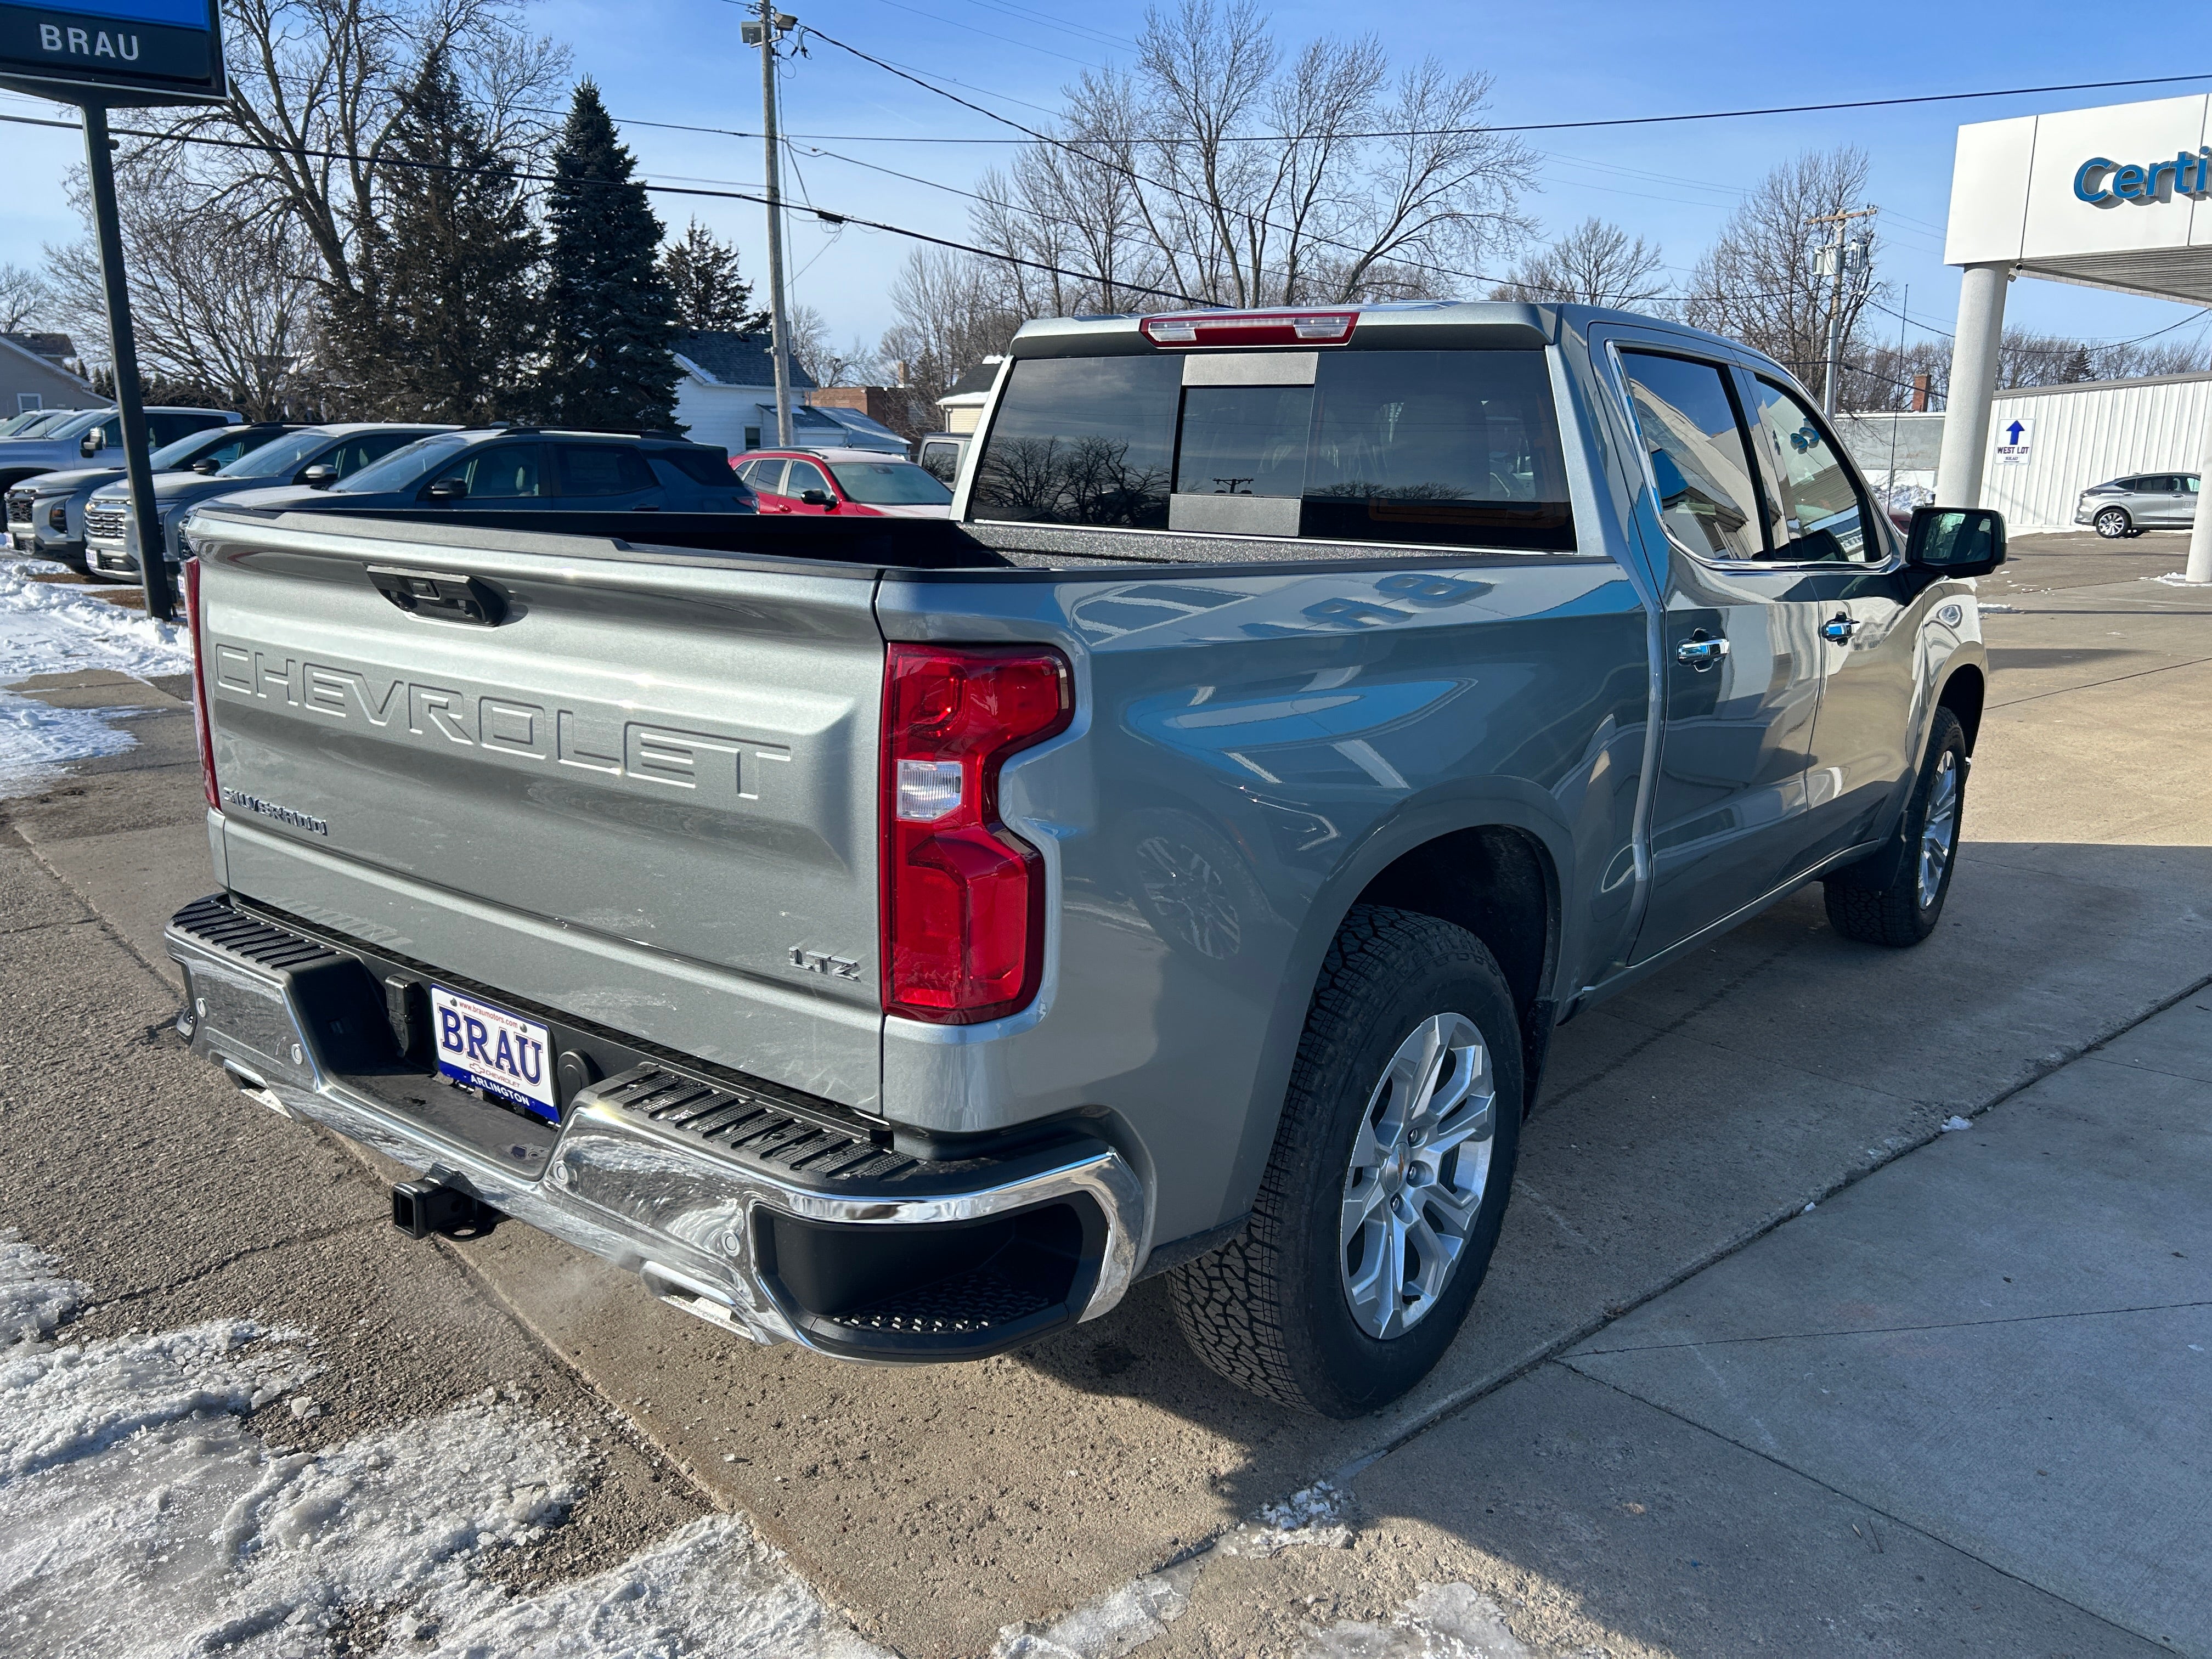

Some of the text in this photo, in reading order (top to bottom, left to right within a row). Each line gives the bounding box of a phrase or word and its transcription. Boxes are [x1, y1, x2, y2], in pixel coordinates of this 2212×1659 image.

[39, 23, 139, 61] BRAU
[1997, 446, 2030, 454] WEST LOT
[216, 642, 791, 799] CHEVROLET
[223, 786, 328, 836] SILVERADO
[788, 946, 861, 983] LTZ
[459, 1001, 518, 1028] www.braumotors.com
[437, 1003, 543, 1087] BRAU
[471, 1074, 530, 1107] ARLINGTON
[486, 1070, 521, 1088] CHEVROLET
